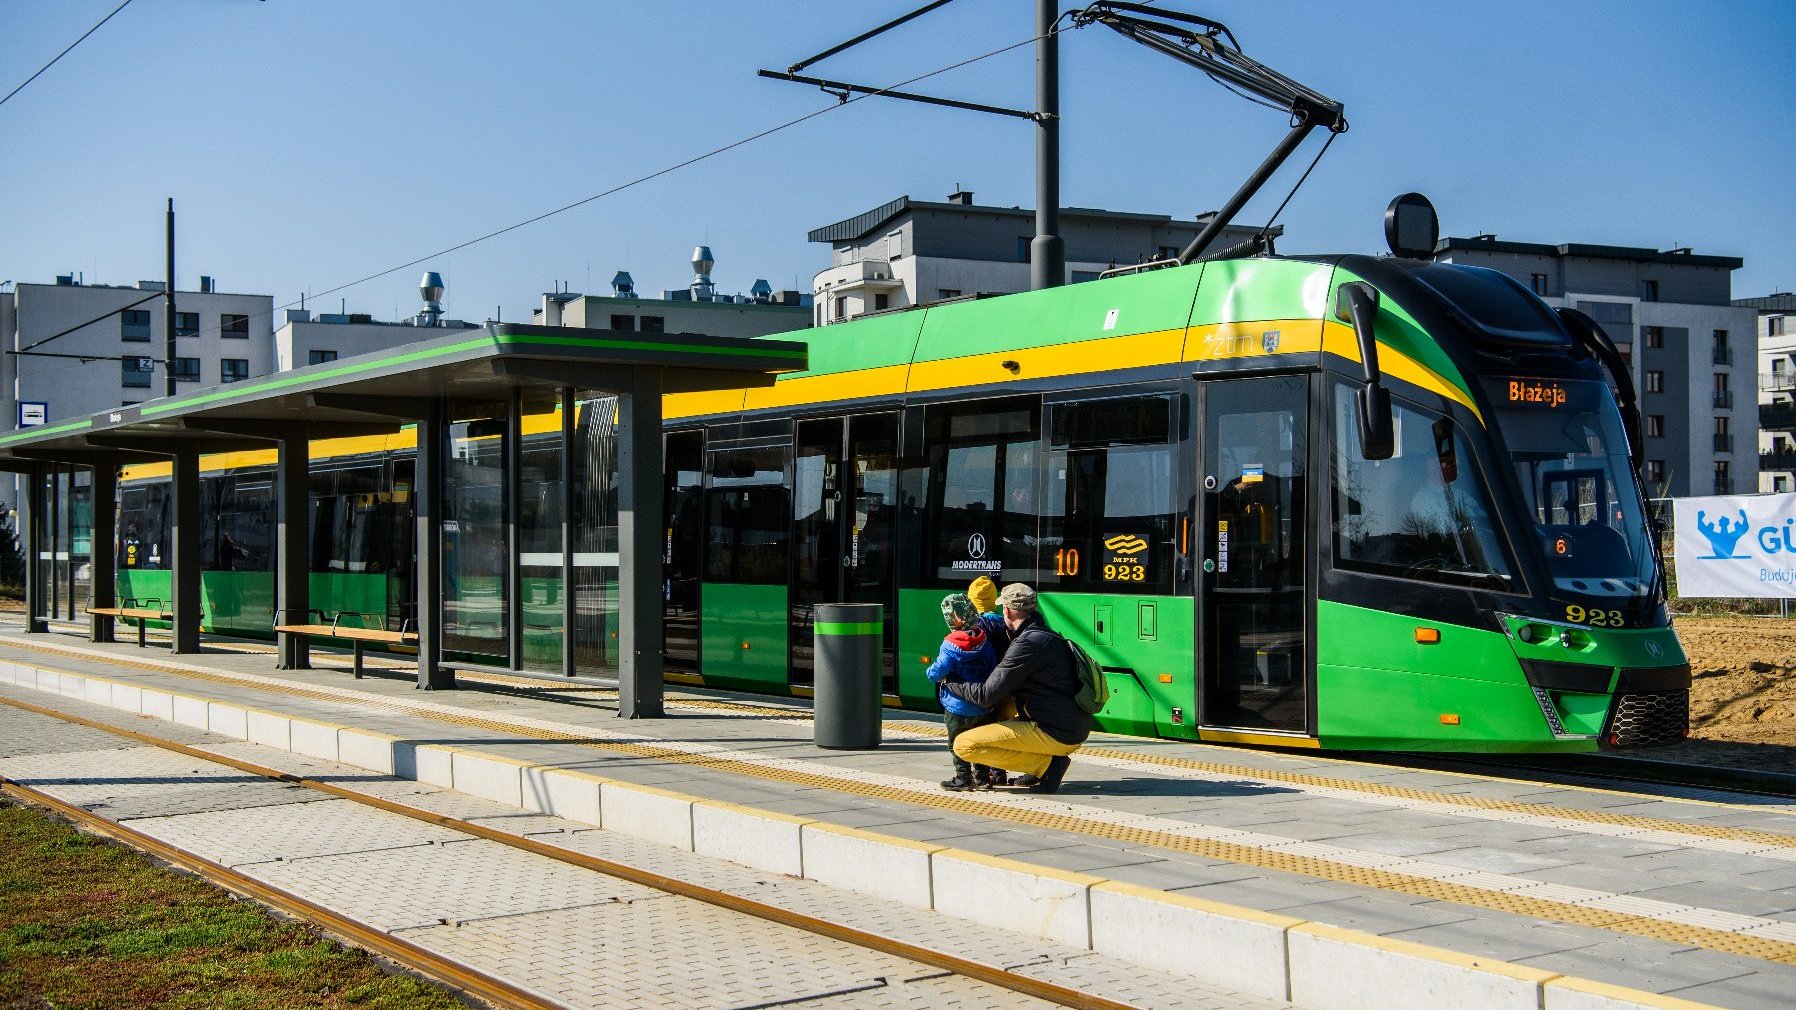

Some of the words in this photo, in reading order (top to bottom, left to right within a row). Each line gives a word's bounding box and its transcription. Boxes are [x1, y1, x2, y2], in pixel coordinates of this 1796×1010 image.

[143, 360, 150, 368] Z
[1509, 381, 1566, 408] Błażeja
[1556, 539, 1566, 554] 6
[951, 560, 1002, 570] MODERTRANS
[1056, 548, 1079, 576] 10
[1112, 556, 1138, 564] MPK
[1103, 564, 1145, 581] 923
[1760, 568, 1796, 585] Buduj
[1566, 604, 1625, 627] 923
